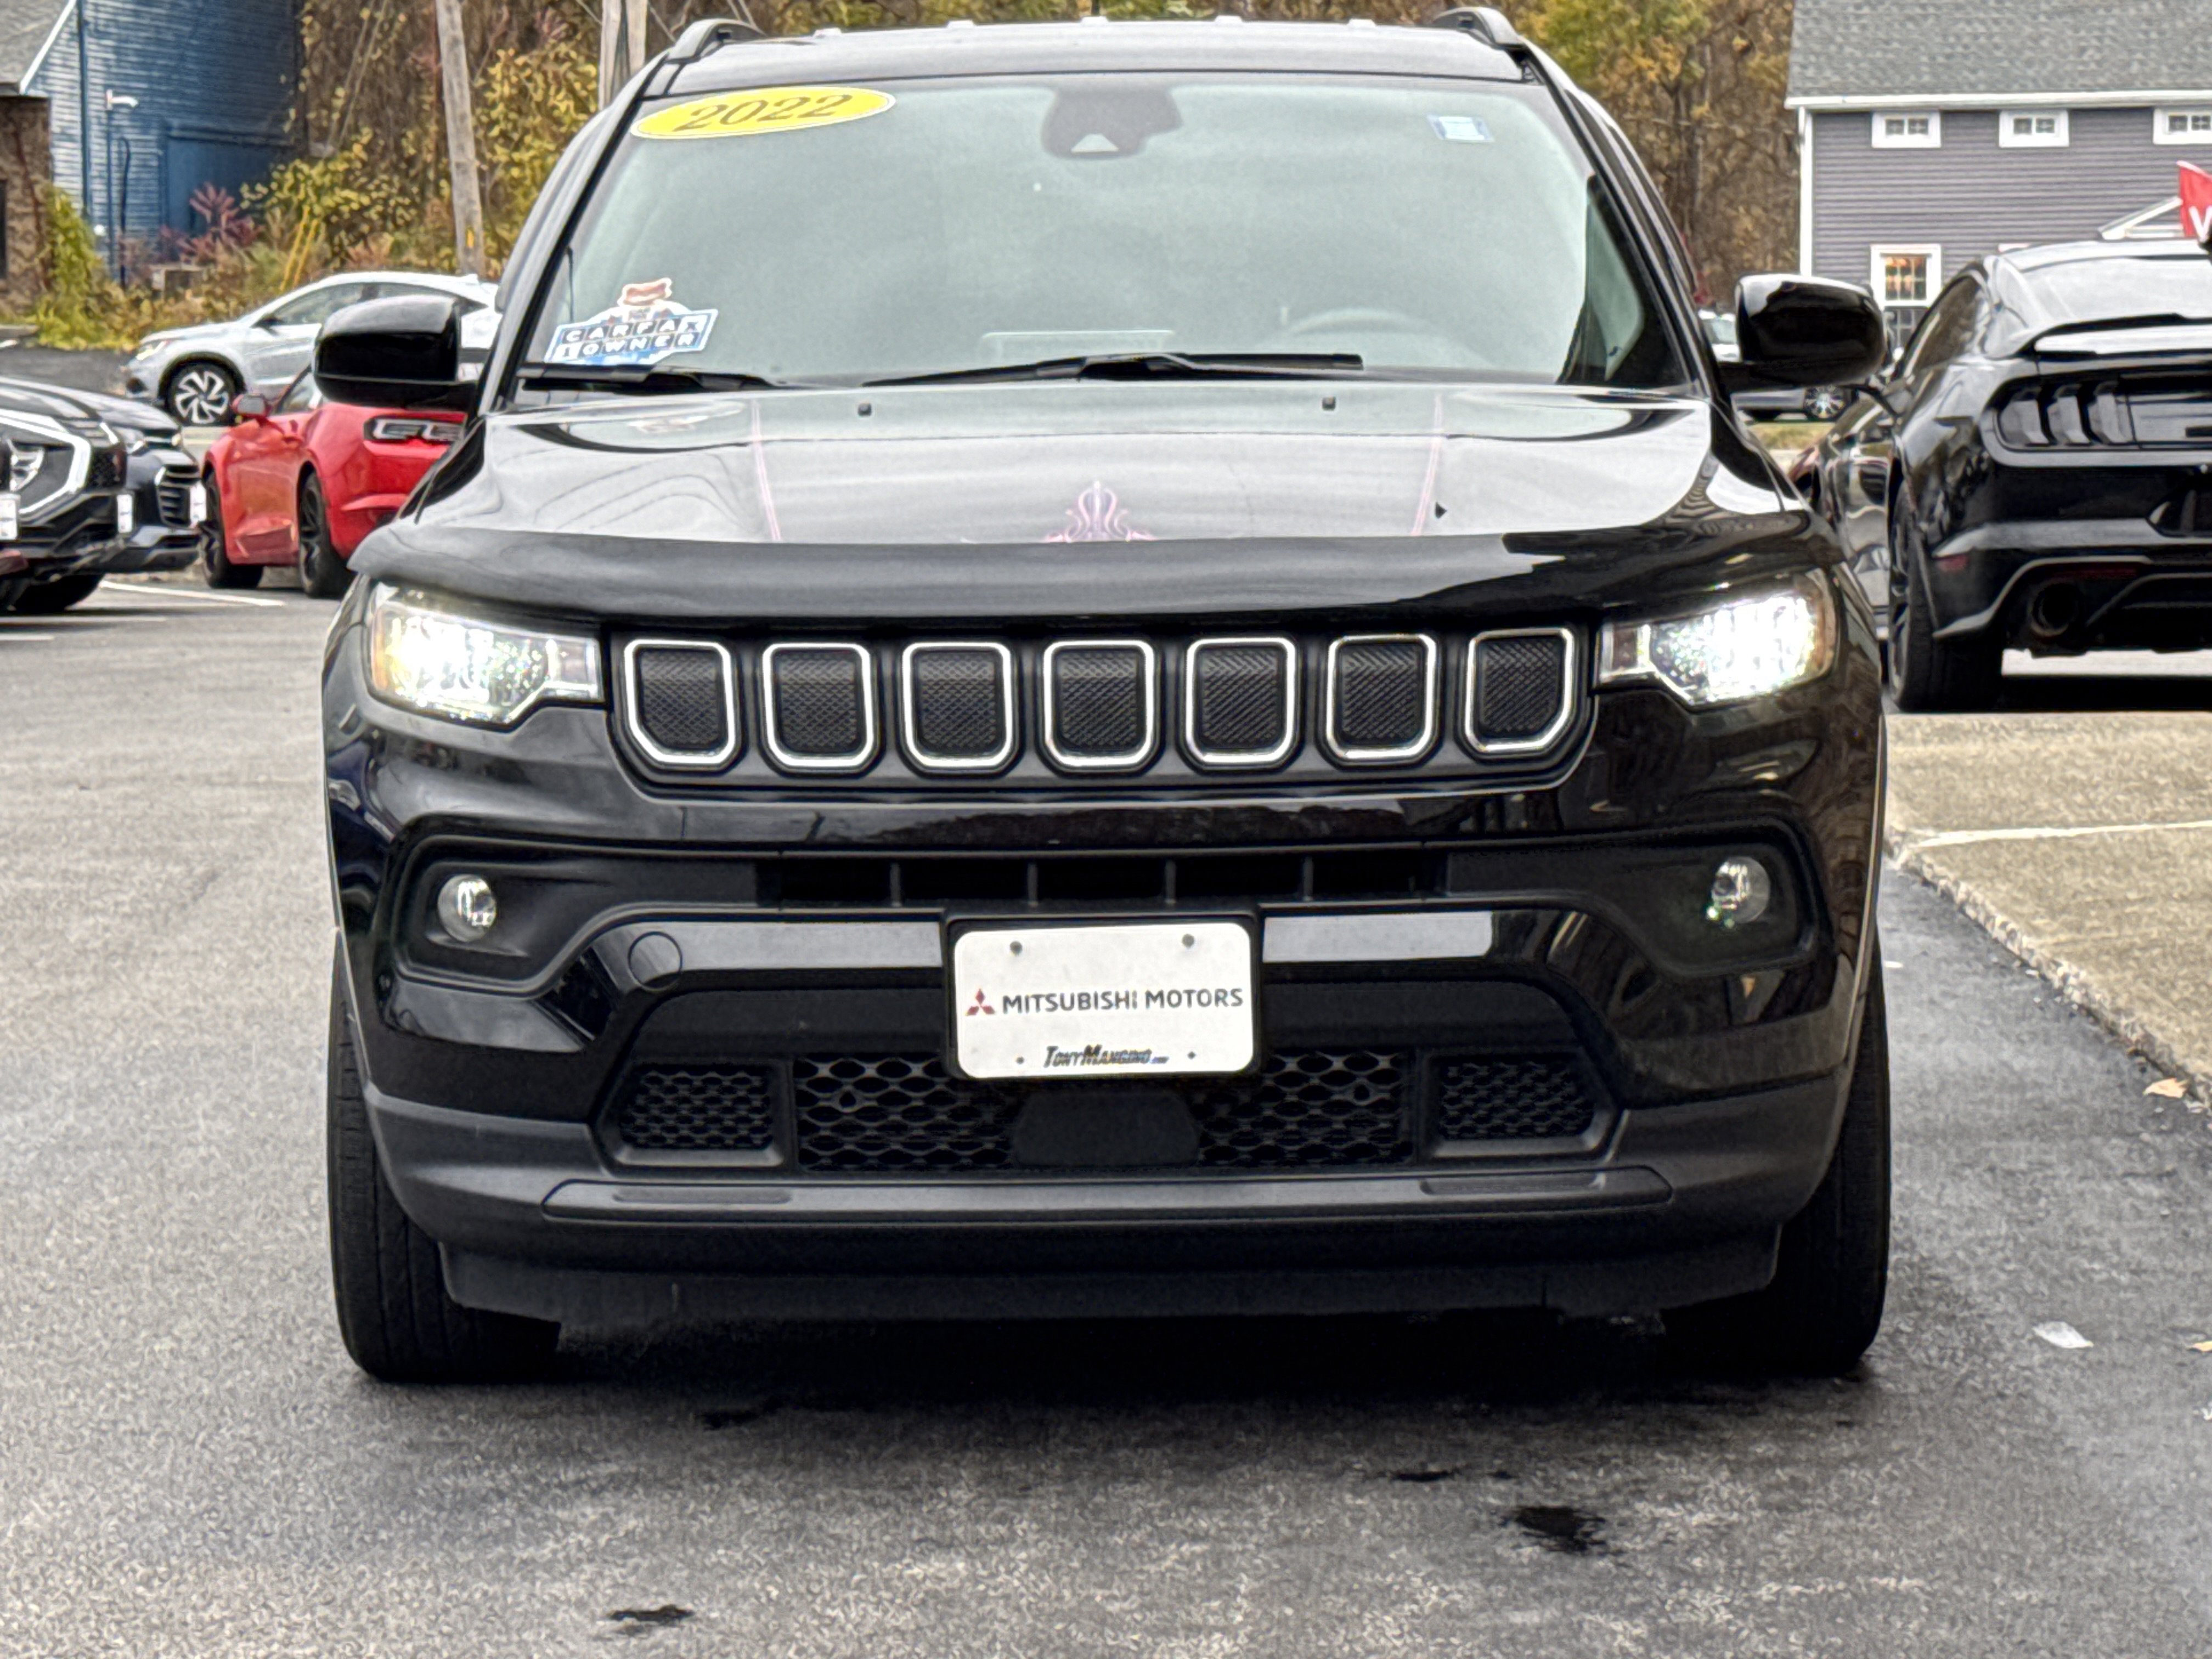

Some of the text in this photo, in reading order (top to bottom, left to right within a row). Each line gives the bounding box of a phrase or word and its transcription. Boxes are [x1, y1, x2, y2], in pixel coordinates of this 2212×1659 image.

[672, 94, 853, 132] 2022
[566, 321, 699, 342] CARFAX
[583, 333, 695, 356] OWNER
[1002, 988, 1244, 1014] MITSUBISHI MOTORS
